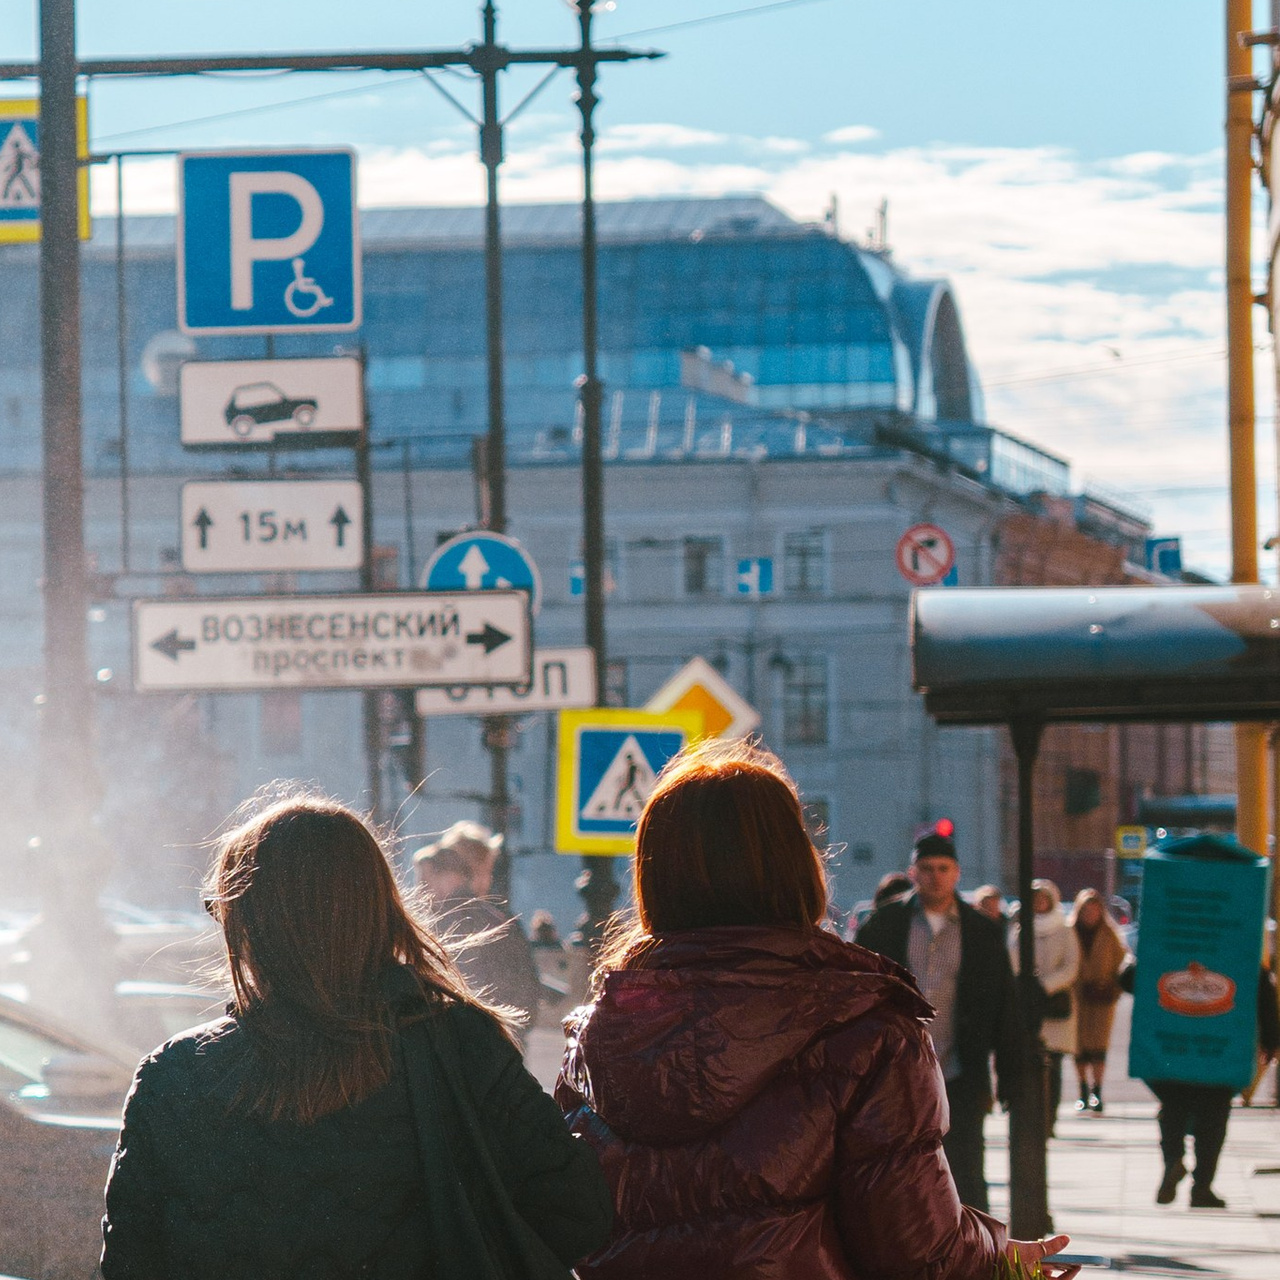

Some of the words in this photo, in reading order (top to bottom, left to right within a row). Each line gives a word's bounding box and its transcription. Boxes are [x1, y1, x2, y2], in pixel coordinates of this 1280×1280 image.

[229, 171, 324, 310] P
[202, 603, 461, 642] ВОЗНЕСЕНСКИЙ
[253, 648, 405, 676] проспект
